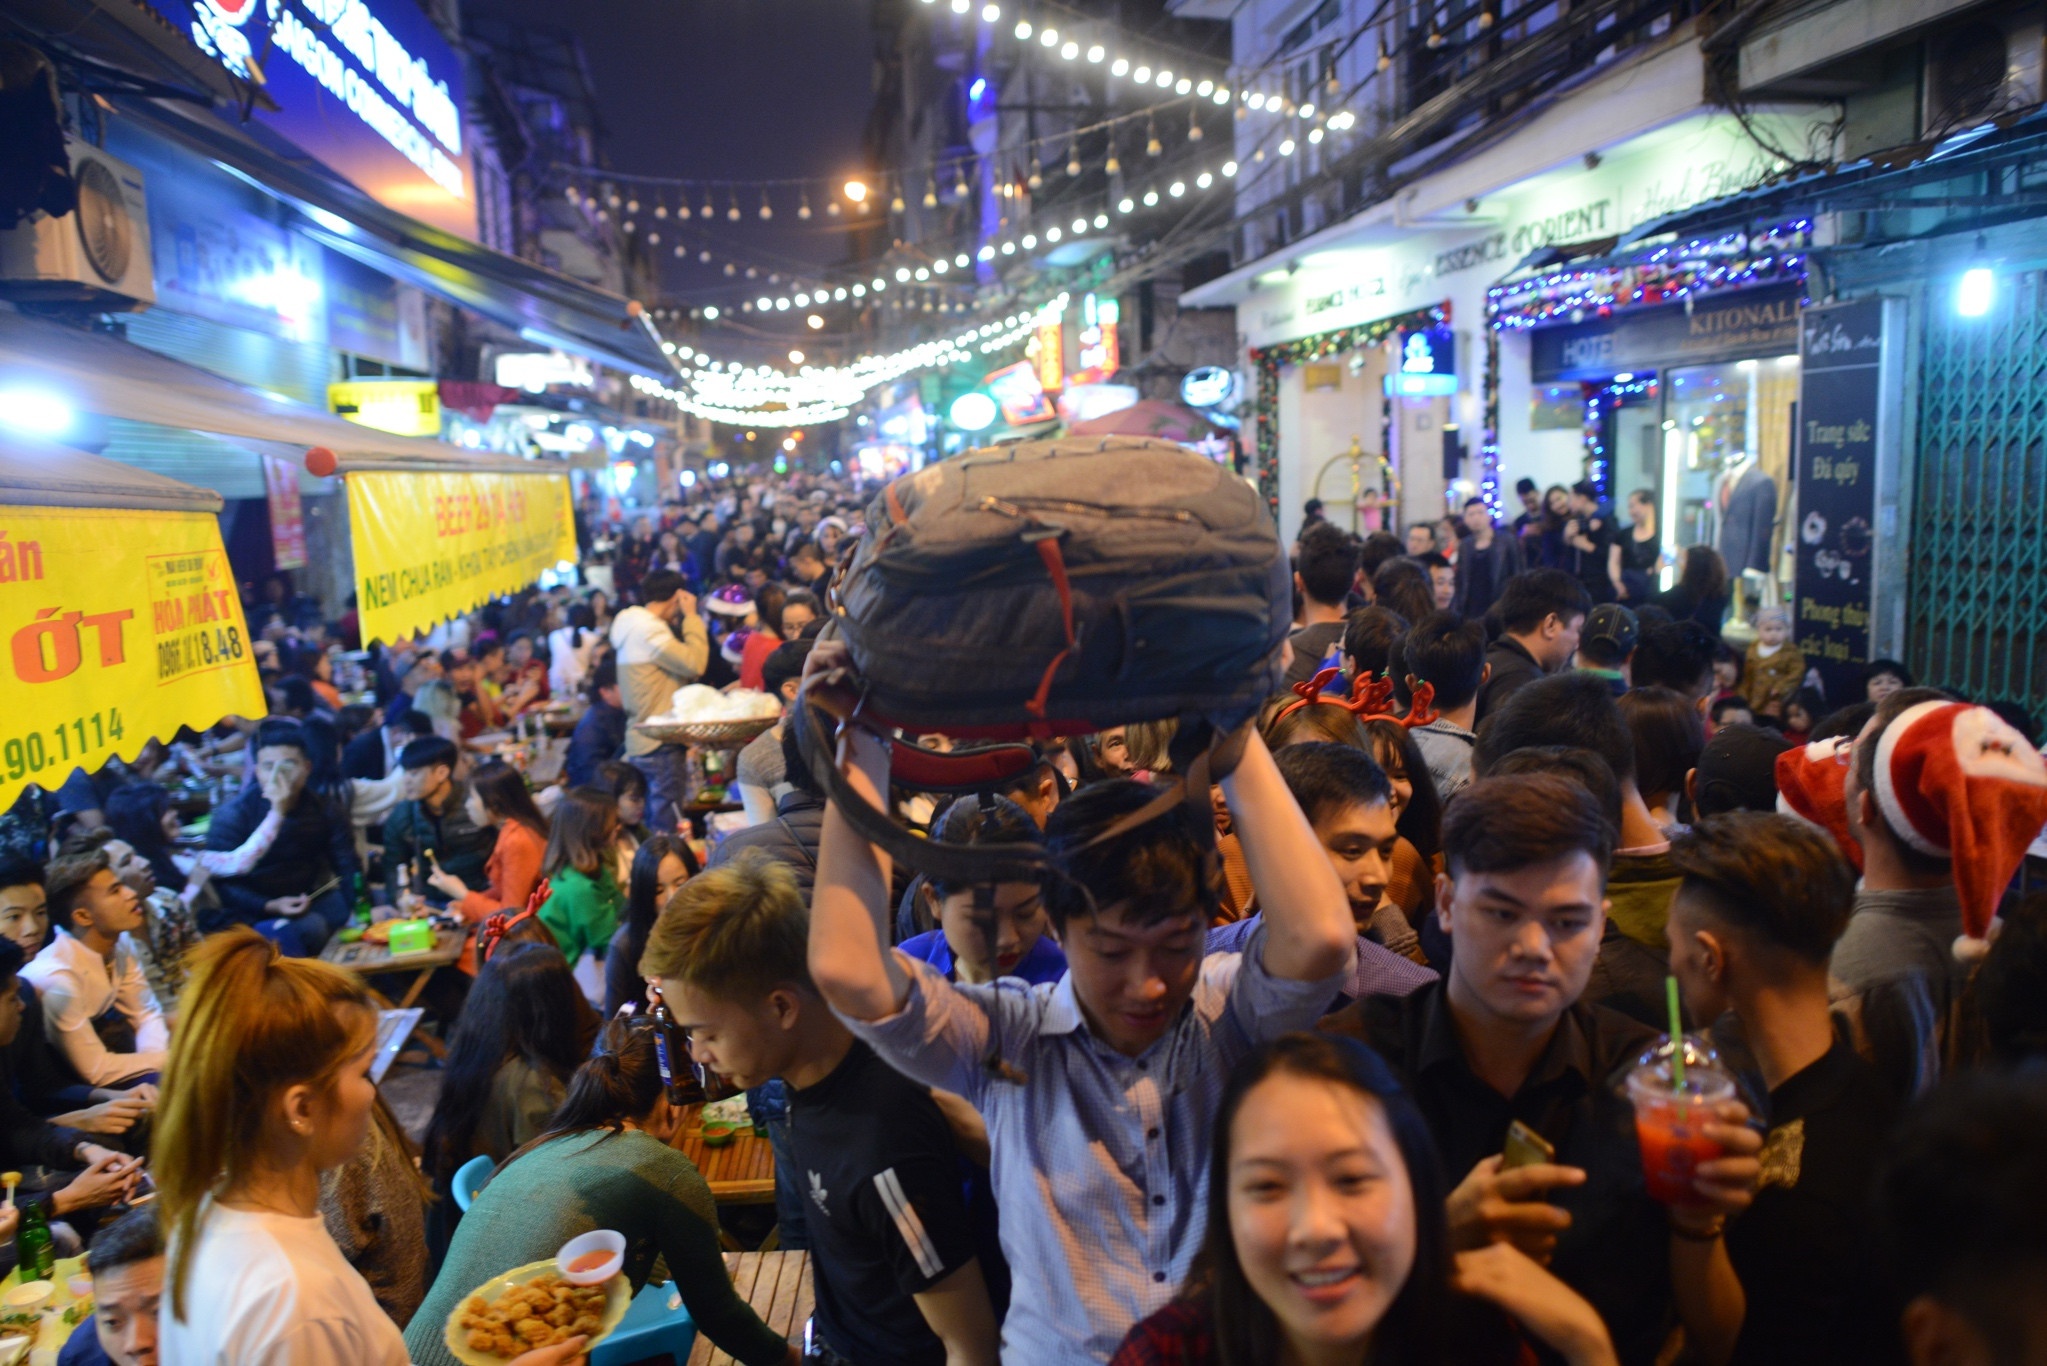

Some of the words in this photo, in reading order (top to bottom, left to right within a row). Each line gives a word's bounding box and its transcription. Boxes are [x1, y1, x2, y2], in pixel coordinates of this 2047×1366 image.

[1806, 419, 1845, 449] Trang
[1812, 456, 1833, 480] Đá
[365, 571, 397, 611] NEM
[11, 606, 134, 684] ỚT
